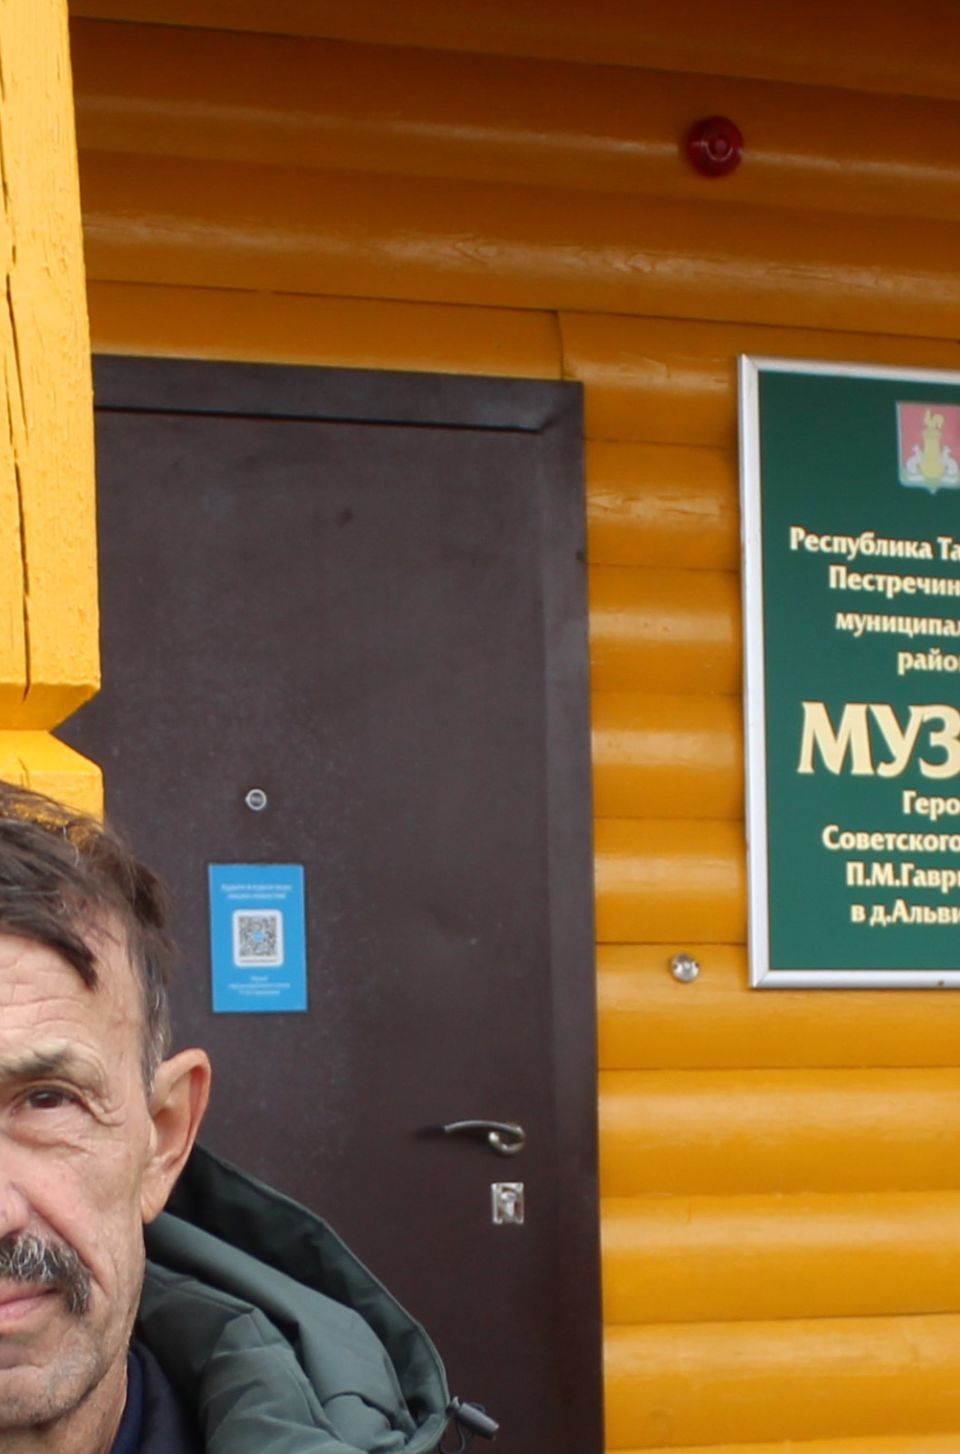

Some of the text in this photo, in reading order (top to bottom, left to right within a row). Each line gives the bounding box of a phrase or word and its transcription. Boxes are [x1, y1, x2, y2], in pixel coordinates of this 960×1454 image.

[790, 525, 934, 561] Республика
[897, 647, 960, 676] райо
[797, 701, 960, 780] МУЗ
[902, 789, 960, 822] Геро
[821, 824, 960, 852] Советского
[845, 860, 960, 894] П.М.Гавр
[850, 904, 866, 924] в
